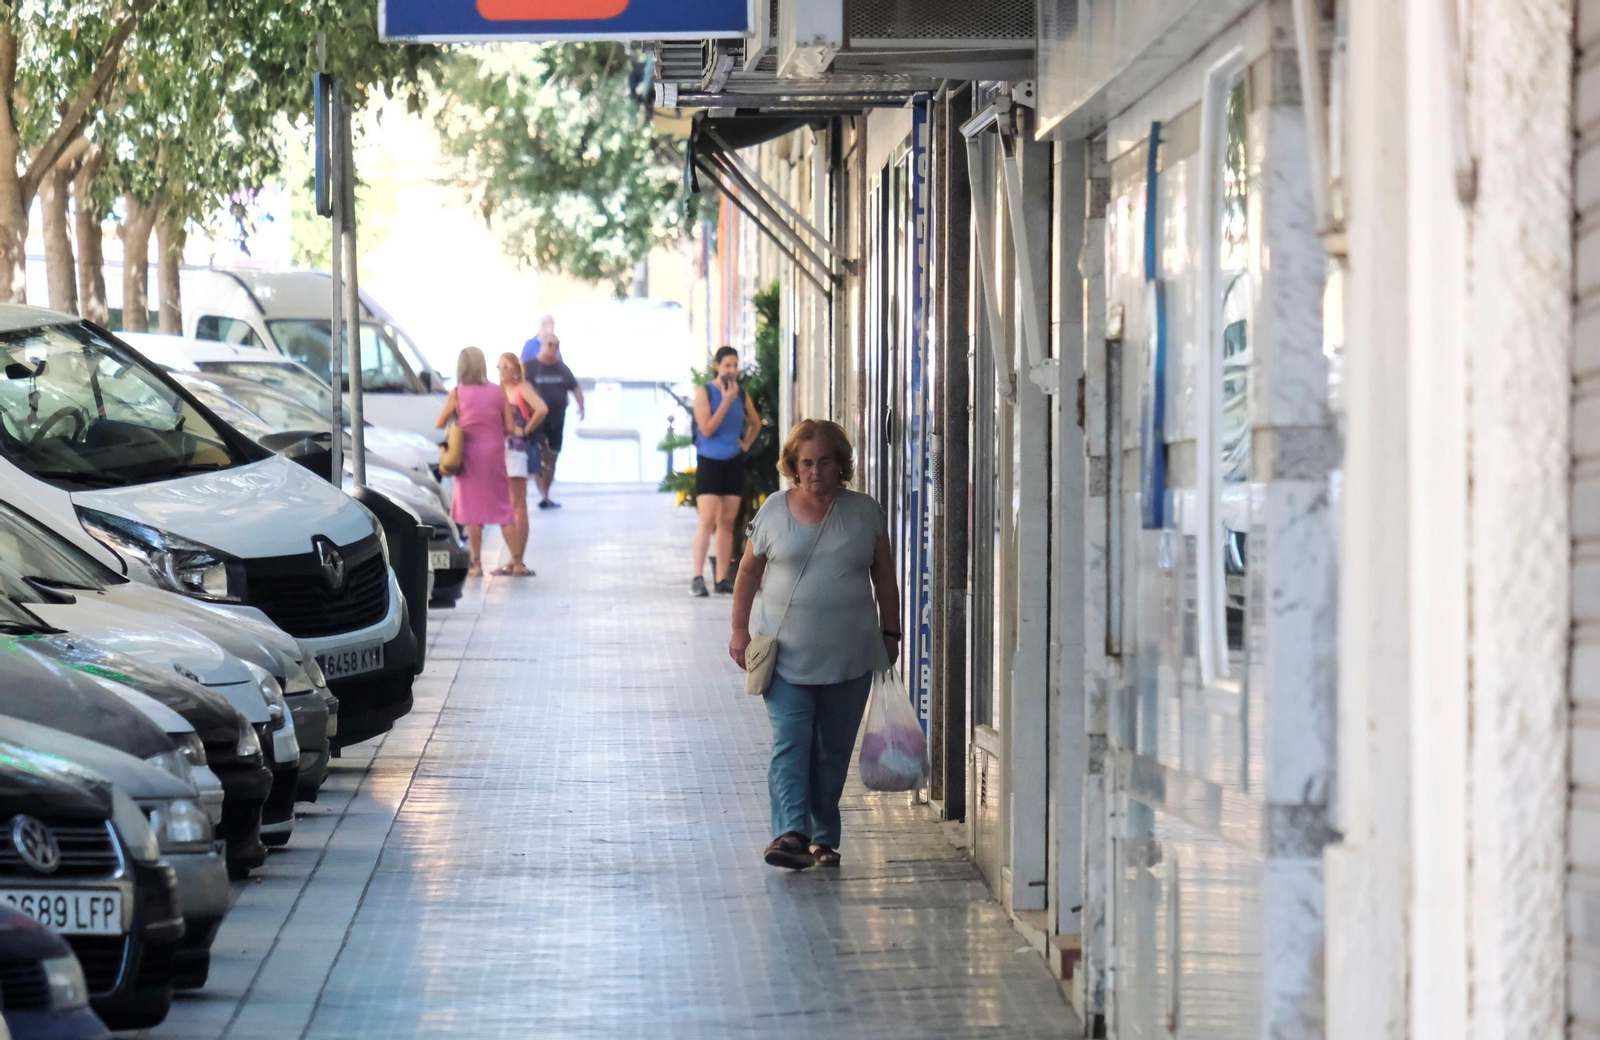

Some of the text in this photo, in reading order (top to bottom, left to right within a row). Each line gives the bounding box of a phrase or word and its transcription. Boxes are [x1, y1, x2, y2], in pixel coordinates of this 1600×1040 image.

[327, 651, 358, 676] 6458
[7, 895, 114, 929] 689 LFP
